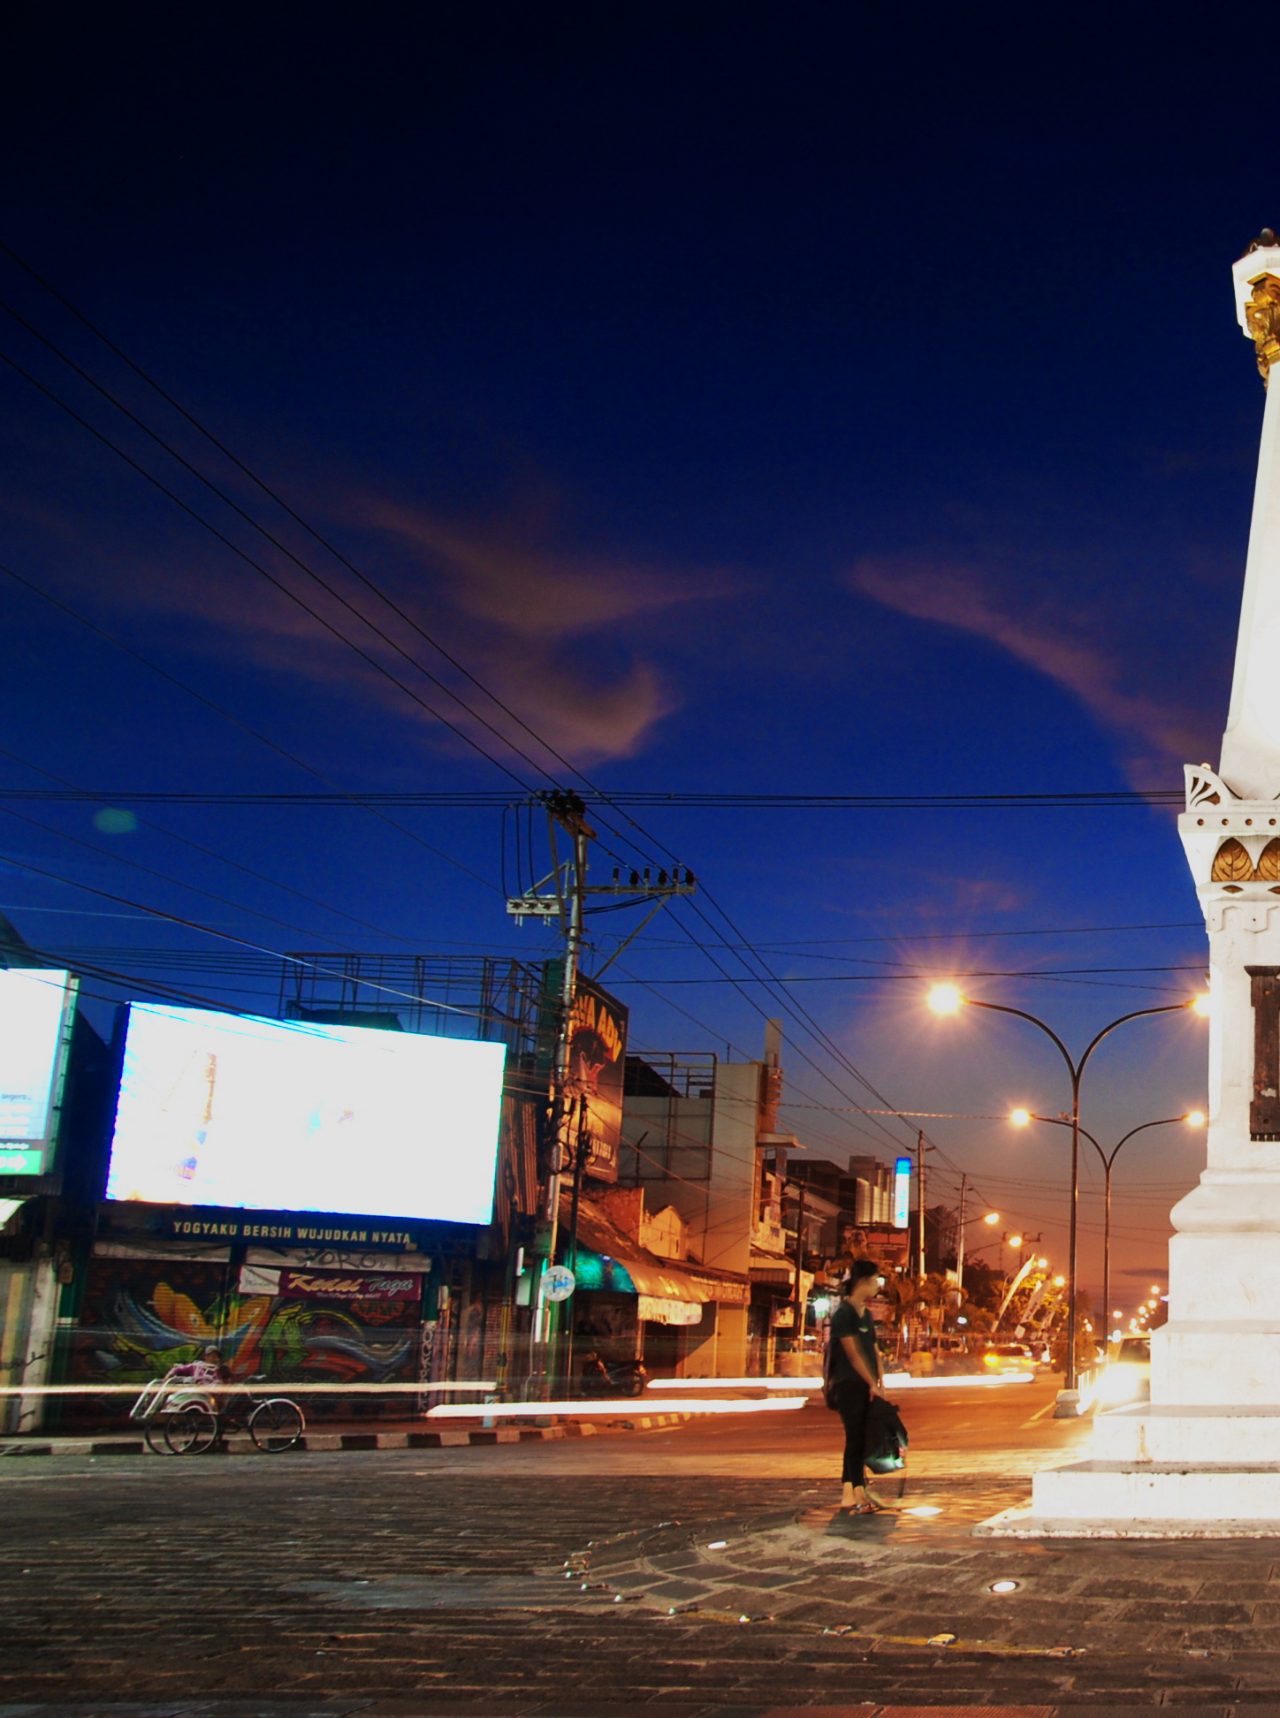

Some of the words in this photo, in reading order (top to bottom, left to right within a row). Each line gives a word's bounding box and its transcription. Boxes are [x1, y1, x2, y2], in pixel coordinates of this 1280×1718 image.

[173, 1221, 238, 1236] YOGYAKU
[243, 1224, 291, 1239] BERSIH
[297, 1227, 367, 1242] WUJUDKAN
[372, 1231, 410, 1245] NYATA
[365, 1276, 414, 1296] Tugu
